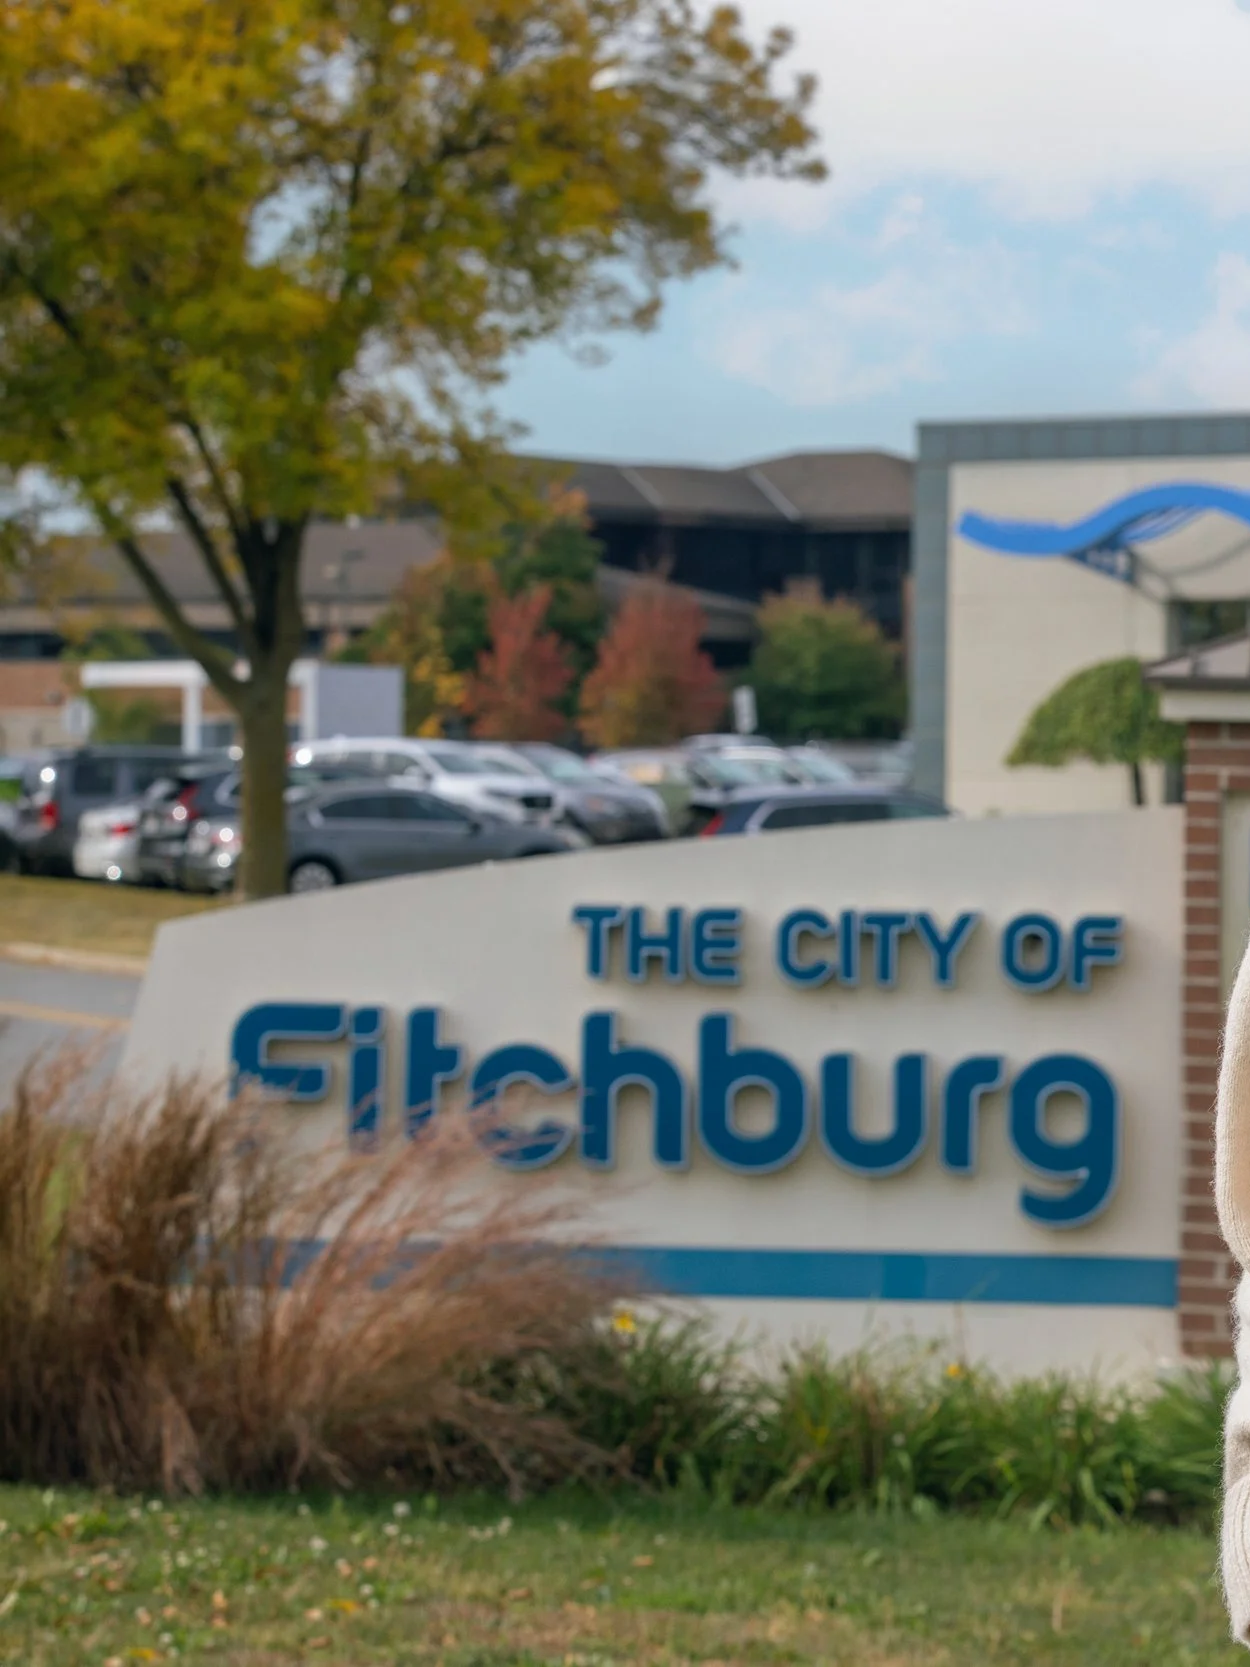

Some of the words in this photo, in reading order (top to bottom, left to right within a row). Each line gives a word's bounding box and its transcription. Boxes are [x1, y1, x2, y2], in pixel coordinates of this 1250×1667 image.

[572, 905, 743, 986] THE
[777, 906, 980, 989] CITY
[1001, 912, 1124, 992] OF
[231, 1001, 1120, 1228] Fitchburg
